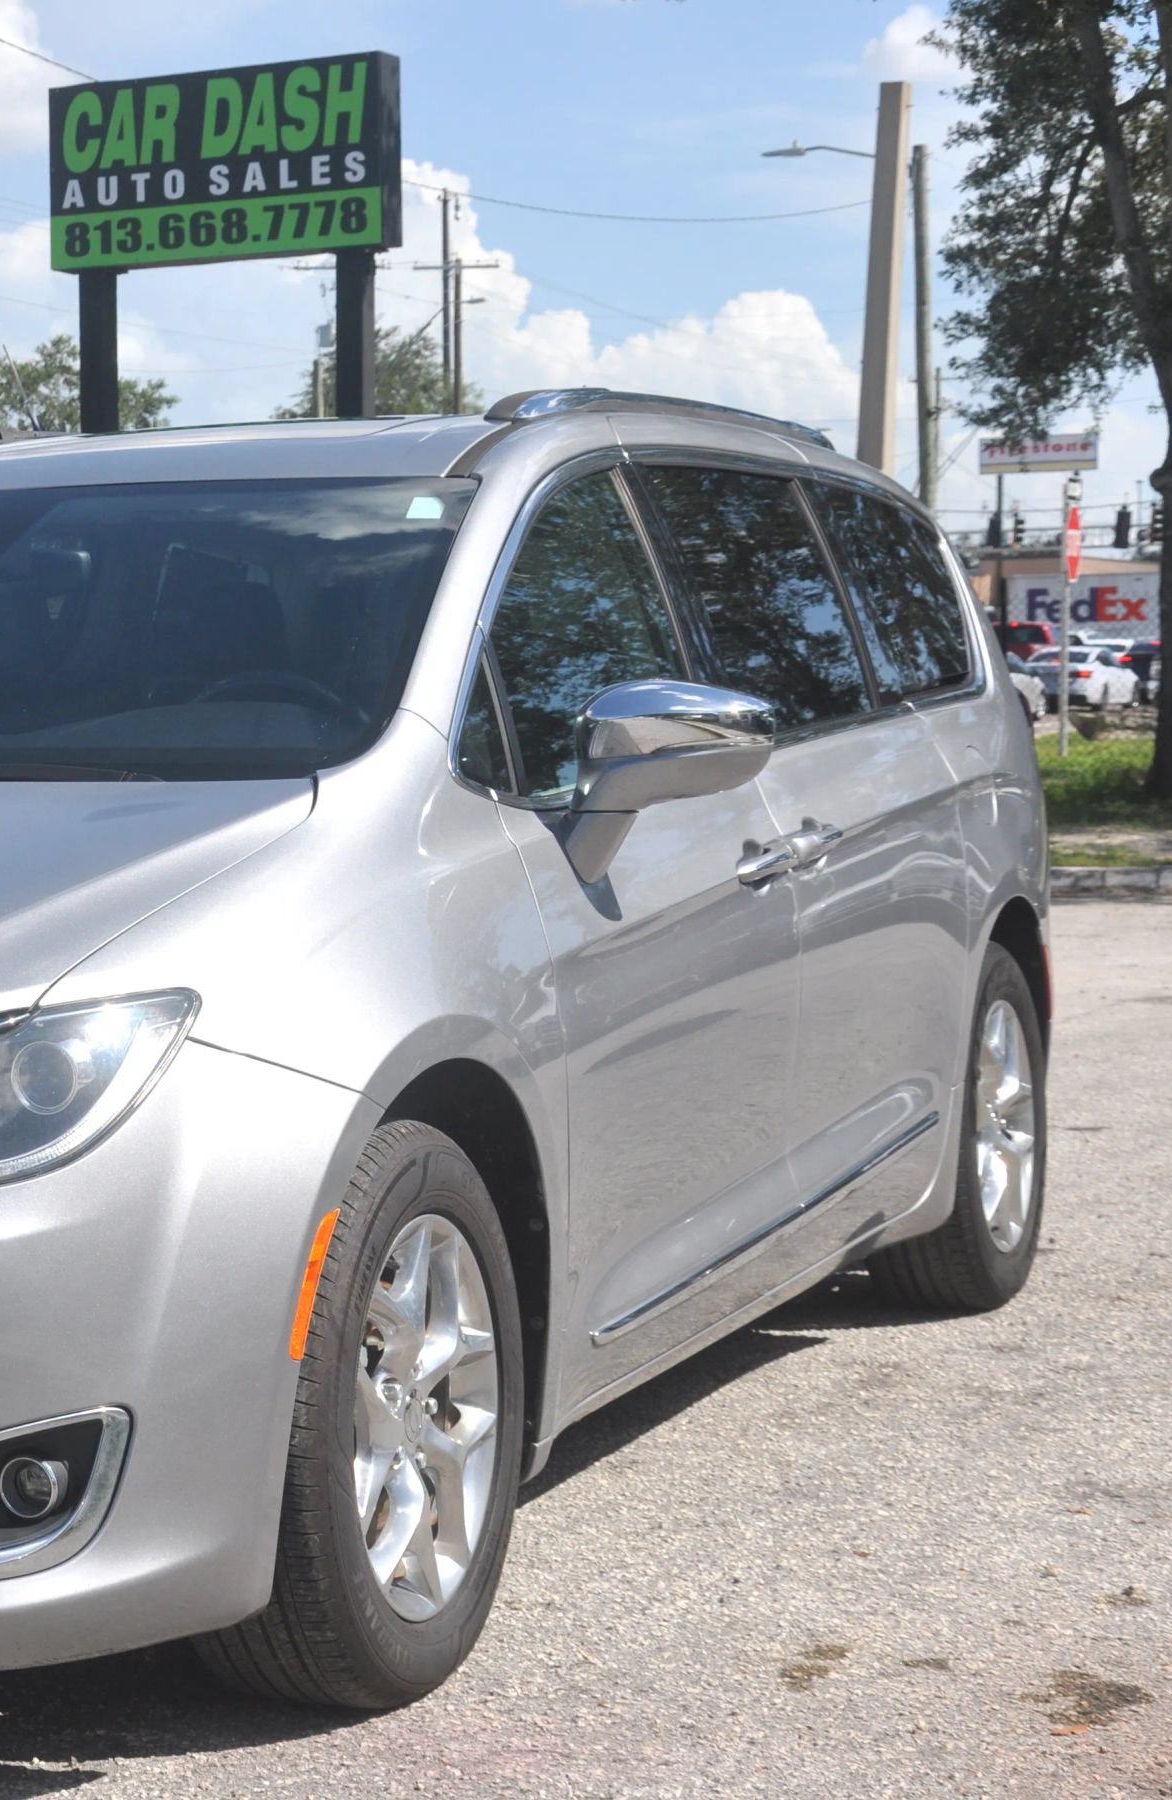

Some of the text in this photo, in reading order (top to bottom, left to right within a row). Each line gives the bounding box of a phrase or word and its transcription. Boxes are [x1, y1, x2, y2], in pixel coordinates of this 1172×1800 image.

[62, 61, 368, 173] CAR DASH
[62, 151, 366, 209] AUTO SALES
[64, 196, 368, 258] 813.668.7778
[1026, 587, 1148, 623] FedEx
